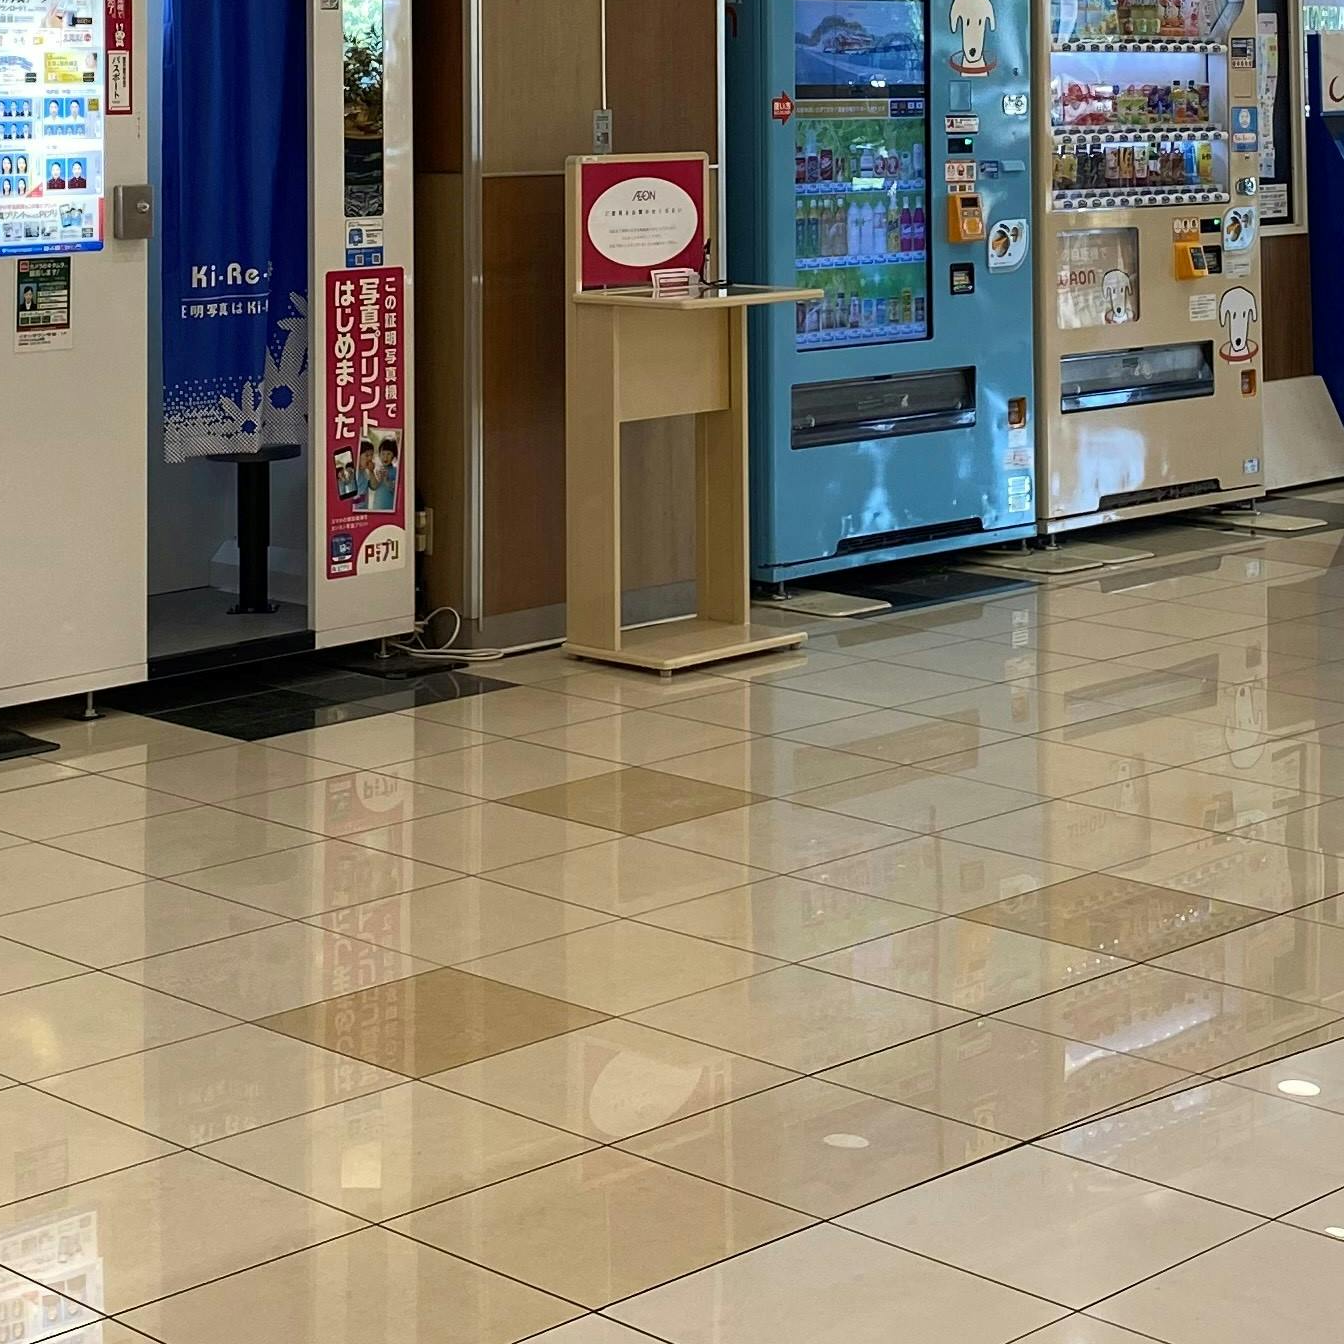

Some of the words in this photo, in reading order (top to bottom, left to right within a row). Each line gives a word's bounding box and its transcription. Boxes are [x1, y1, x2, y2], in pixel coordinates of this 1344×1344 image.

[111, 56, 121, 99] パスポート
[334, 281, 356, 440] はじめました
[360, 278, 380, 438] 写真プリント
[384, 276, 398, 418] この証明写真機で
